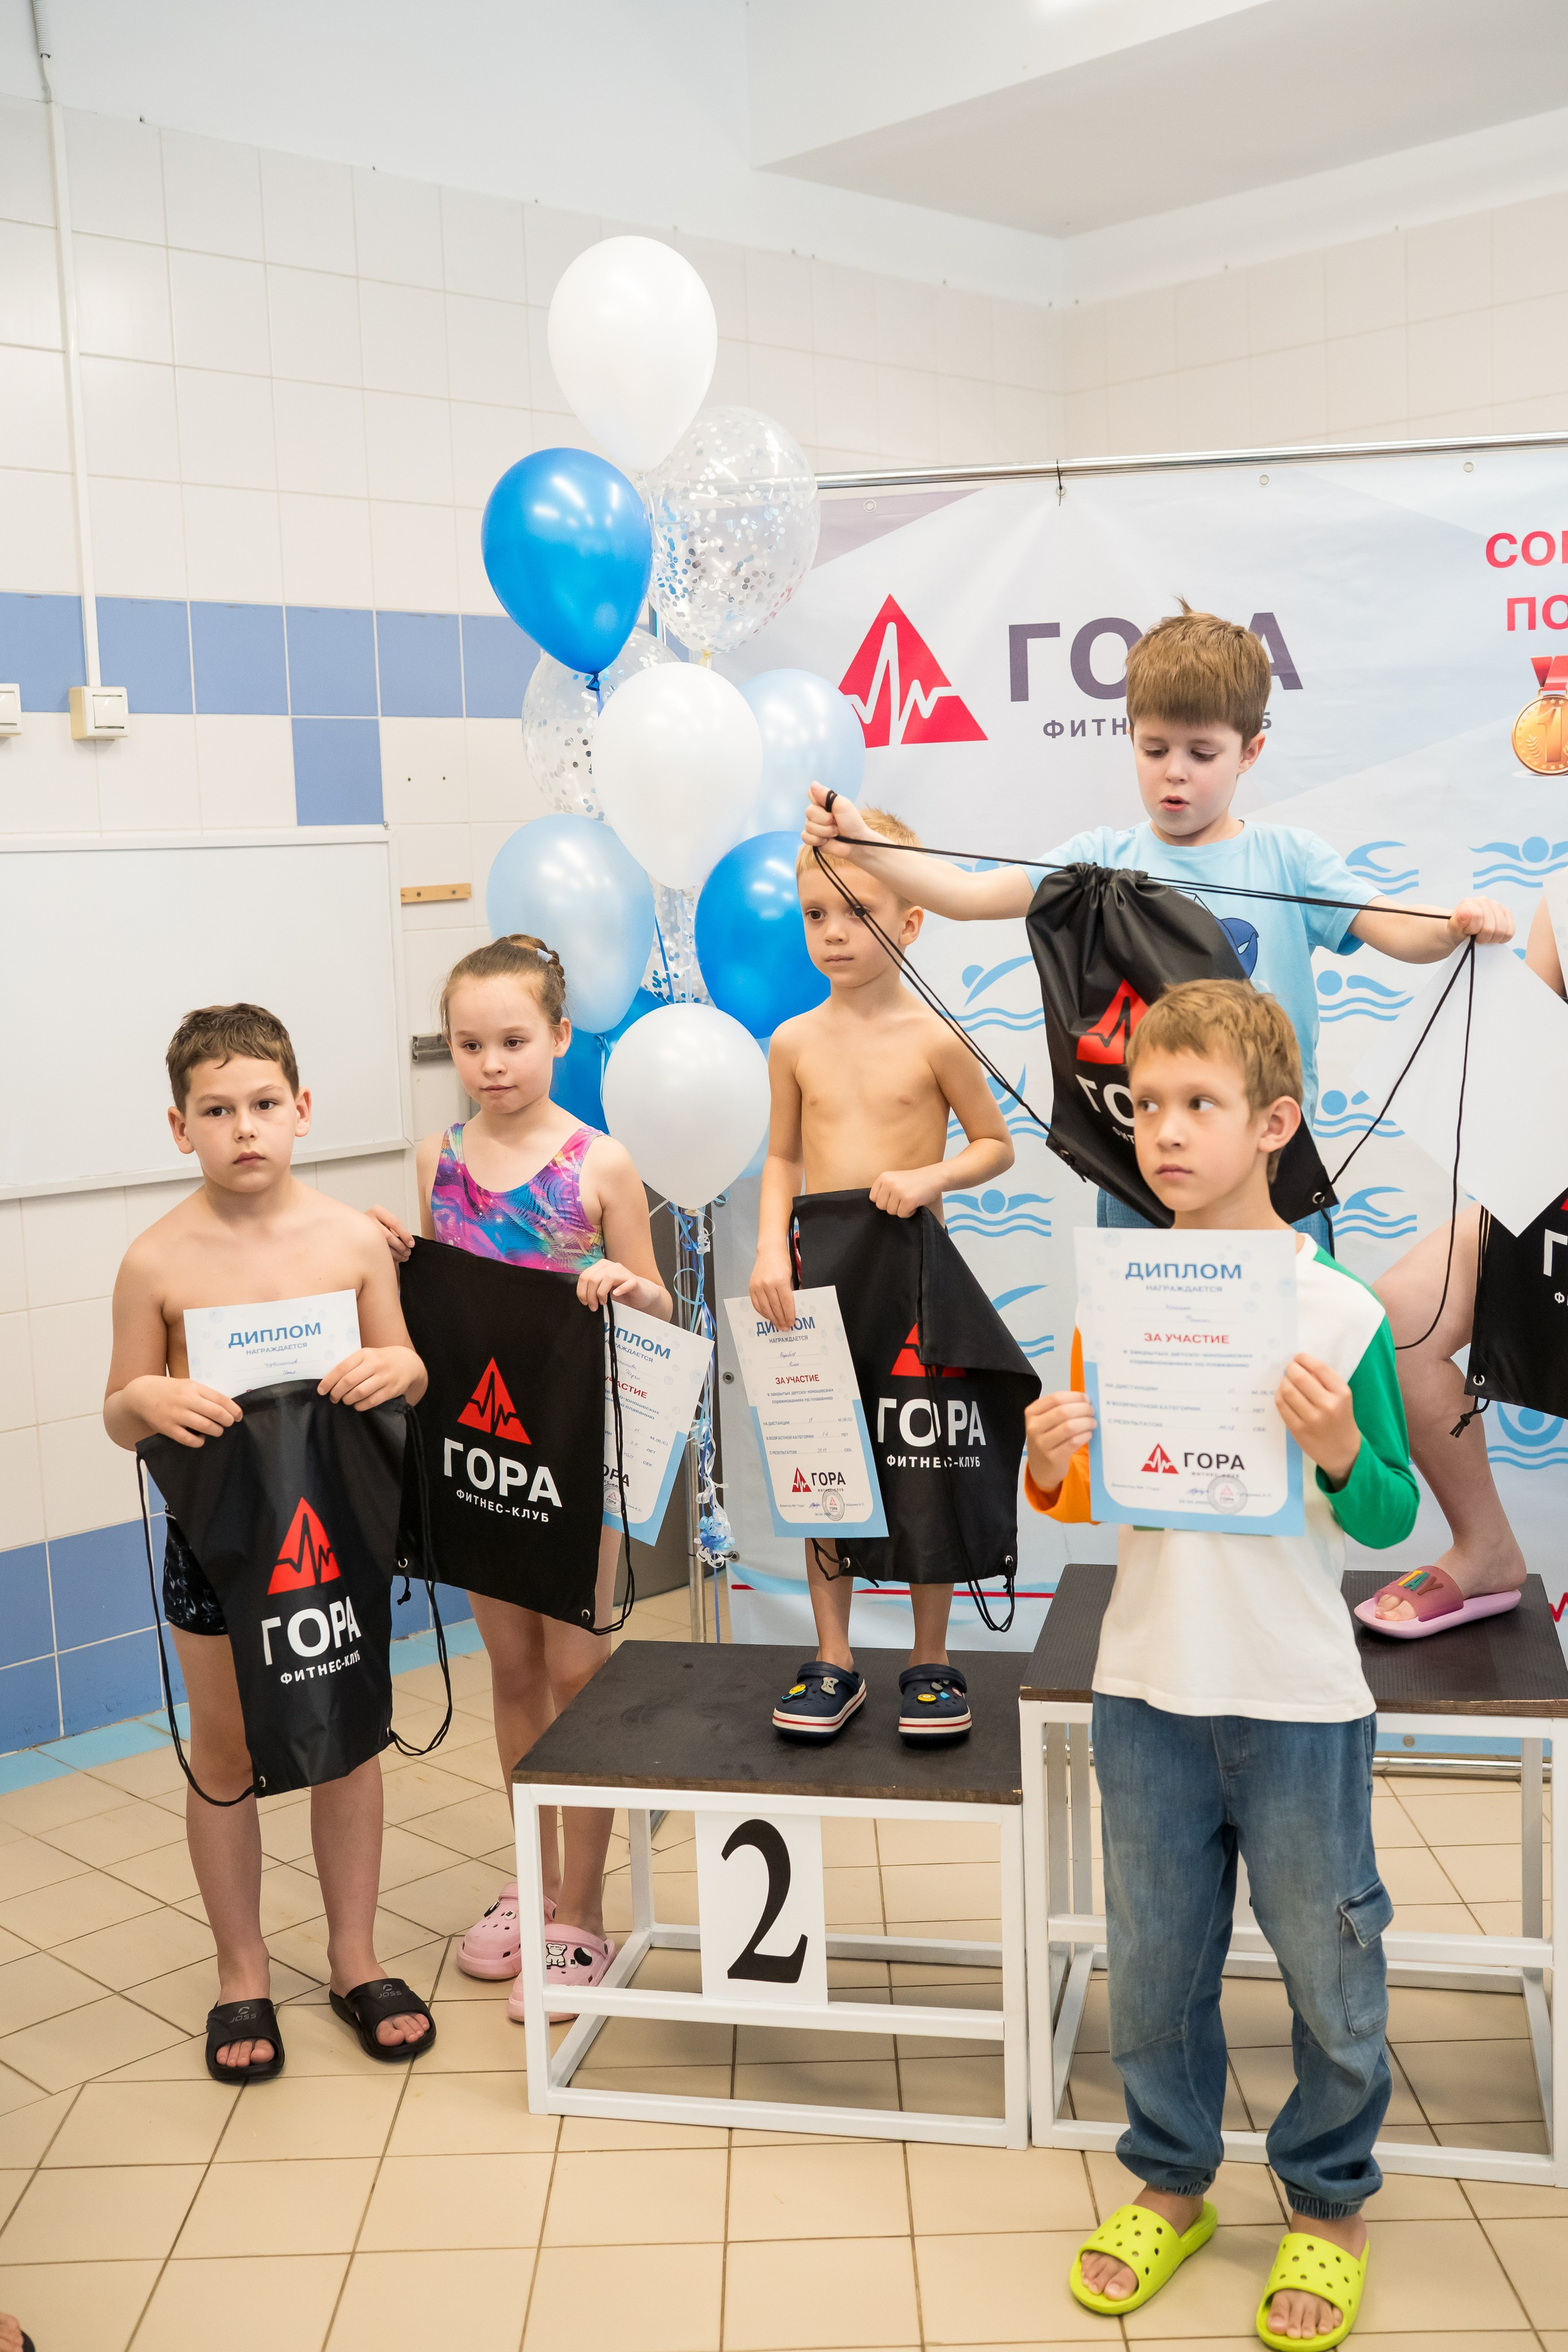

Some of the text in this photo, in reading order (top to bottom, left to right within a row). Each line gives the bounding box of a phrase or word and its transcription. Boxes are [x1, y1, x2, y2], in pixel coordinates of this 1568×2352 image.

[1008, 612, 1304, 703] ГОА
[1125, 1262, 1242, 1281] ДИПЛОМ
[228, 1322, 322, 1349] ДИПЛОМ
[756, 1316, 816, 1336] ДИОМ
[769, 1335, 809, 1344] НАГРАЖДАЕТСЯ
[1144, 1332, 1230, 1344] ЗА УЧАСТИЕ
[246, 1342, 307, 1355] НАГРАЖДАЕТСЯ
[786, 1374, 820, 1384] УЧАСТИЕ
[625, 1405, 655, 1420] плаванию
[877, 1397, 987, 1447] ГОРА
[887, 1454, 981, 1468] ФИТНЕС-КЛУБ
[1183, 1452, 1245, 1471] ГОРА
[444, 1437, 563, 1508] ГОРА
[811, 1471, 846, 1486] ГОРА
[456, 1488, 549, 1523] ФИТНЕС-КЛУБ
[261, 1596, 362, 1666] ГОРА
[721, 1819, 808, 1983] 2
[230, 2012, 257, 2023] JOSS
